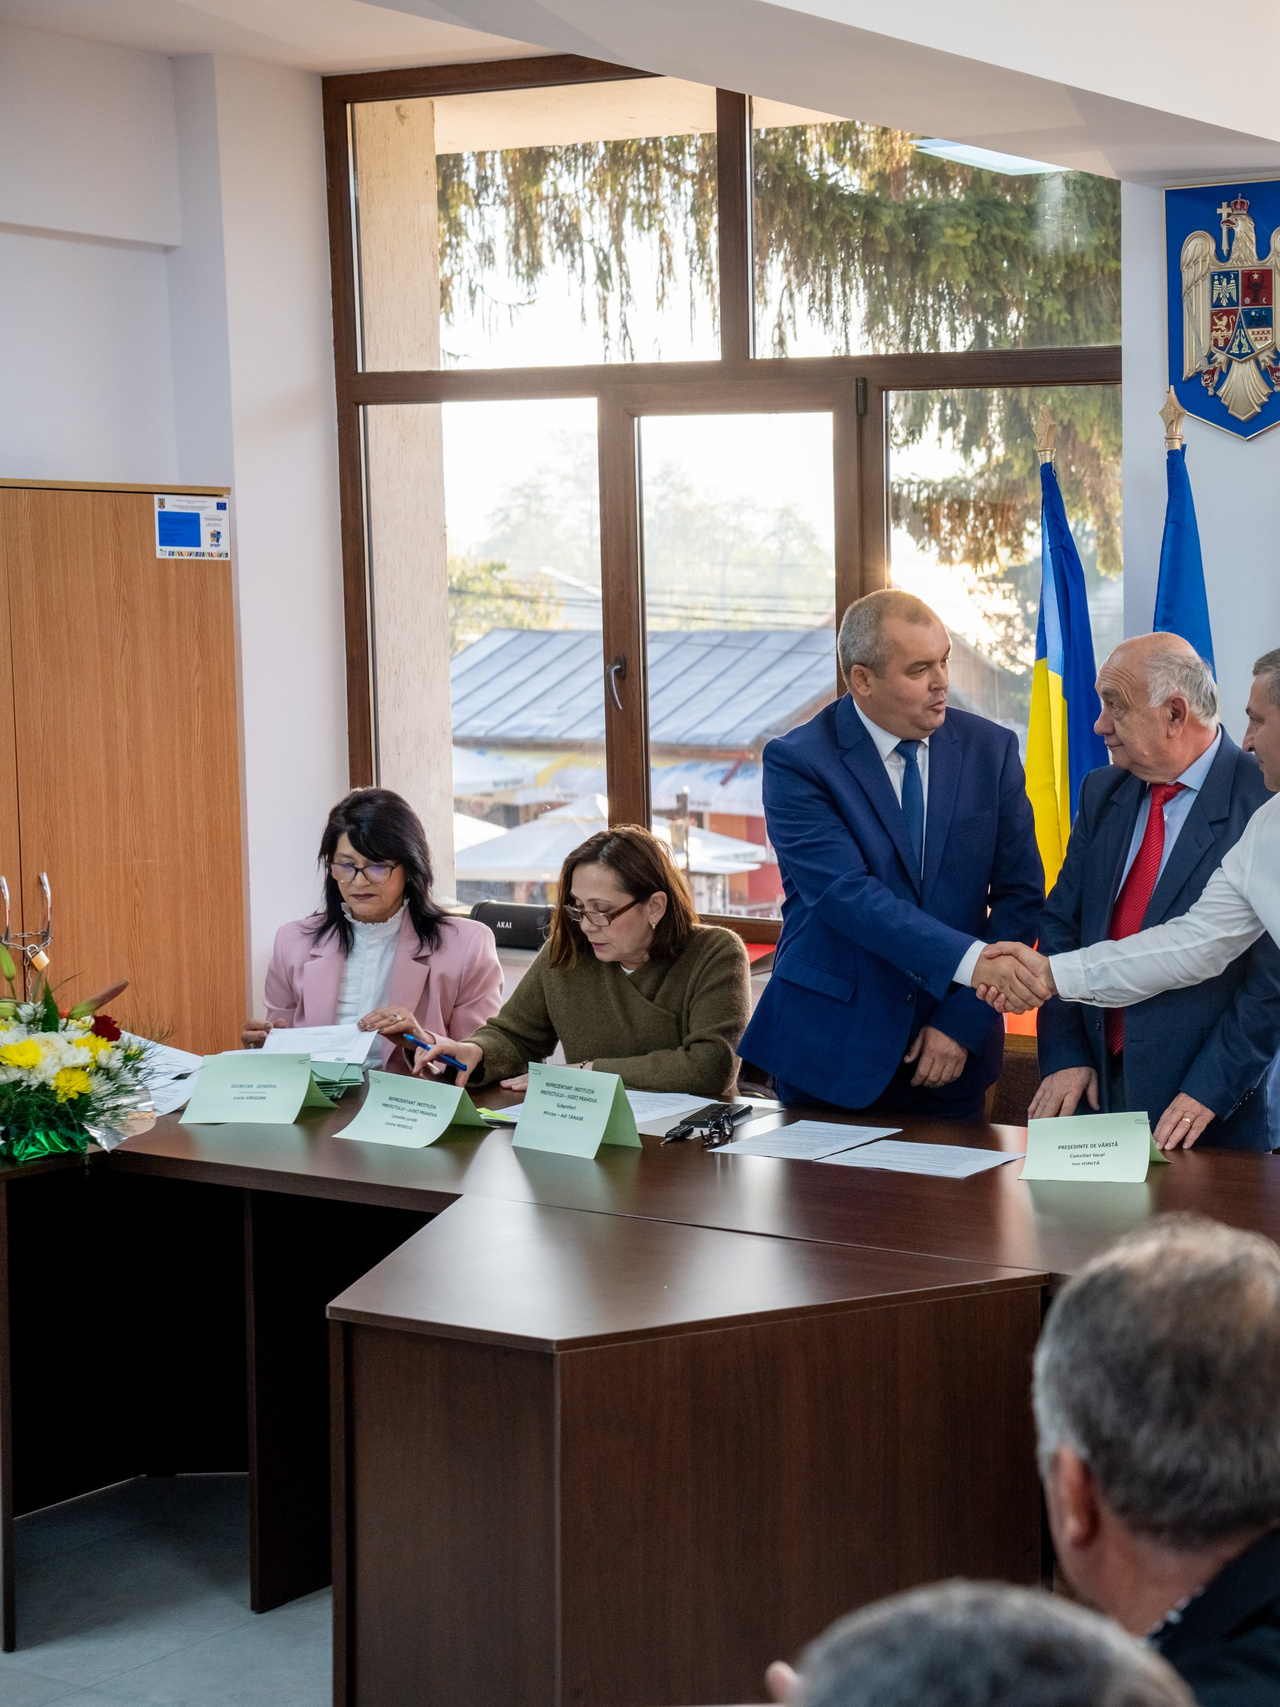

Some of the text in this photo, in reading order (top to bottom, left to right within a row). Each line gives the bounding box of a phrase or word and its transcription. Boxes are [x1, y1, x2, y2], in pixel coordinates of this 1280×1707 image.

[496, 921, 512, 929] AKAI
[545, 1082, 573, 1090] REPREZENTANT
[1057, 1143, 1089, 1151] PREȘEDINTE
